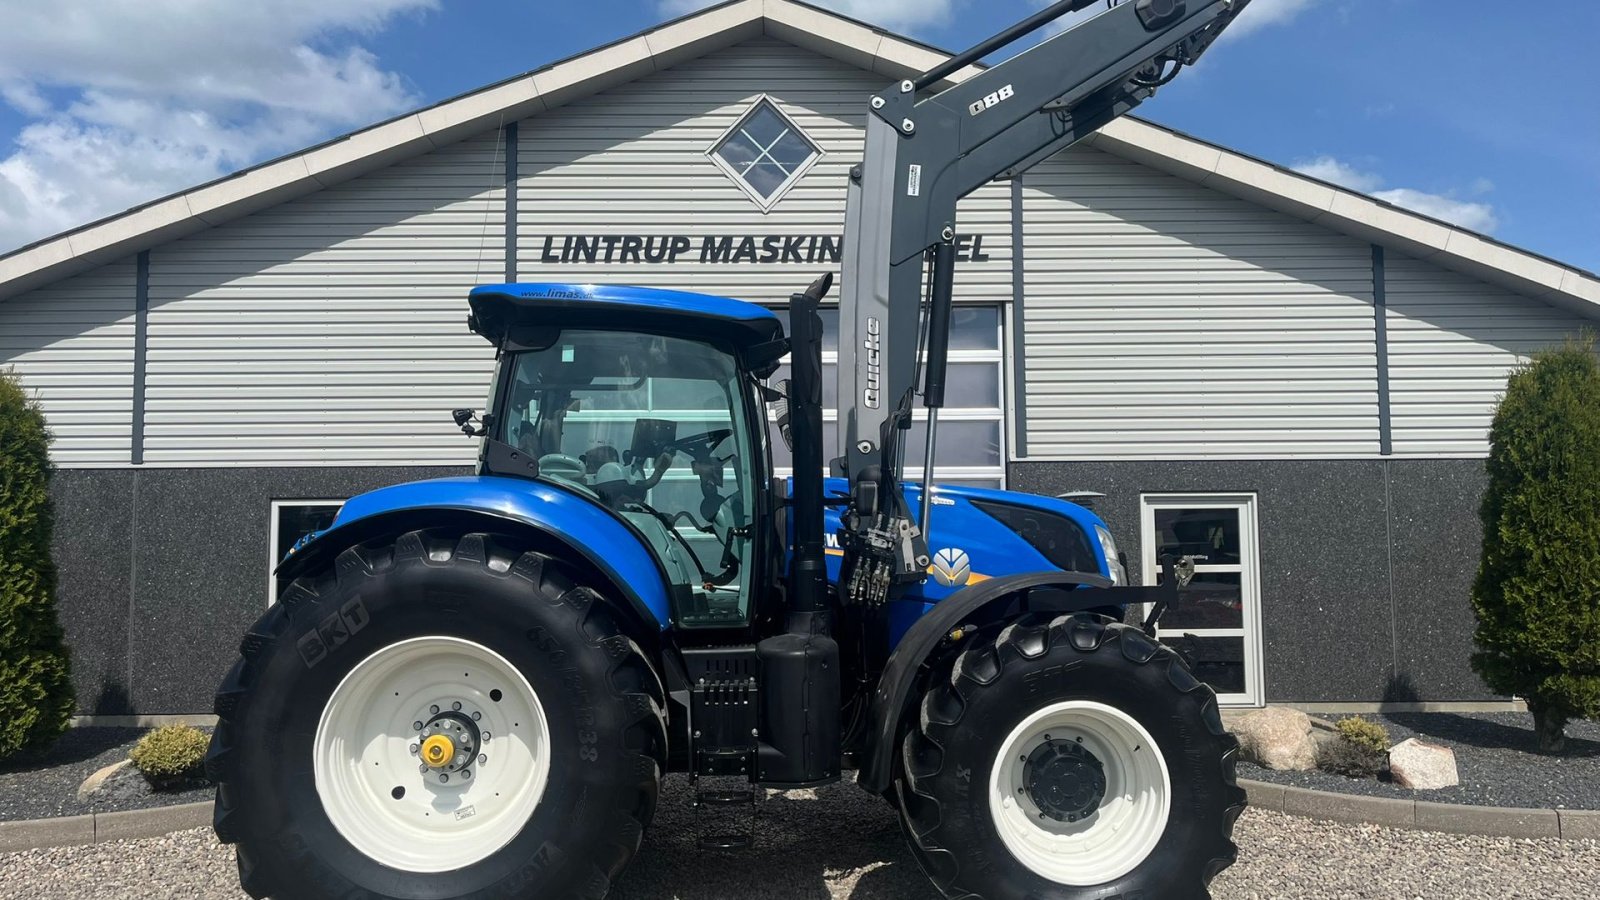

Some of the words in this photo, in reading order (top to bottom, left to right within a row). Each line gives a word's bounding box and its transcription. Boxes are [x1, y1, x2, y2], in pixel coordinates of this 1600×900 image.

[968, 83, 1015, 116] Q88
[541, 235, 691, 263] LINTRUP
[699, 235, 990, 263] MASKINEL
[863, 316, 880, 410] Quicke
[297, 596, 368, 668] BKT
